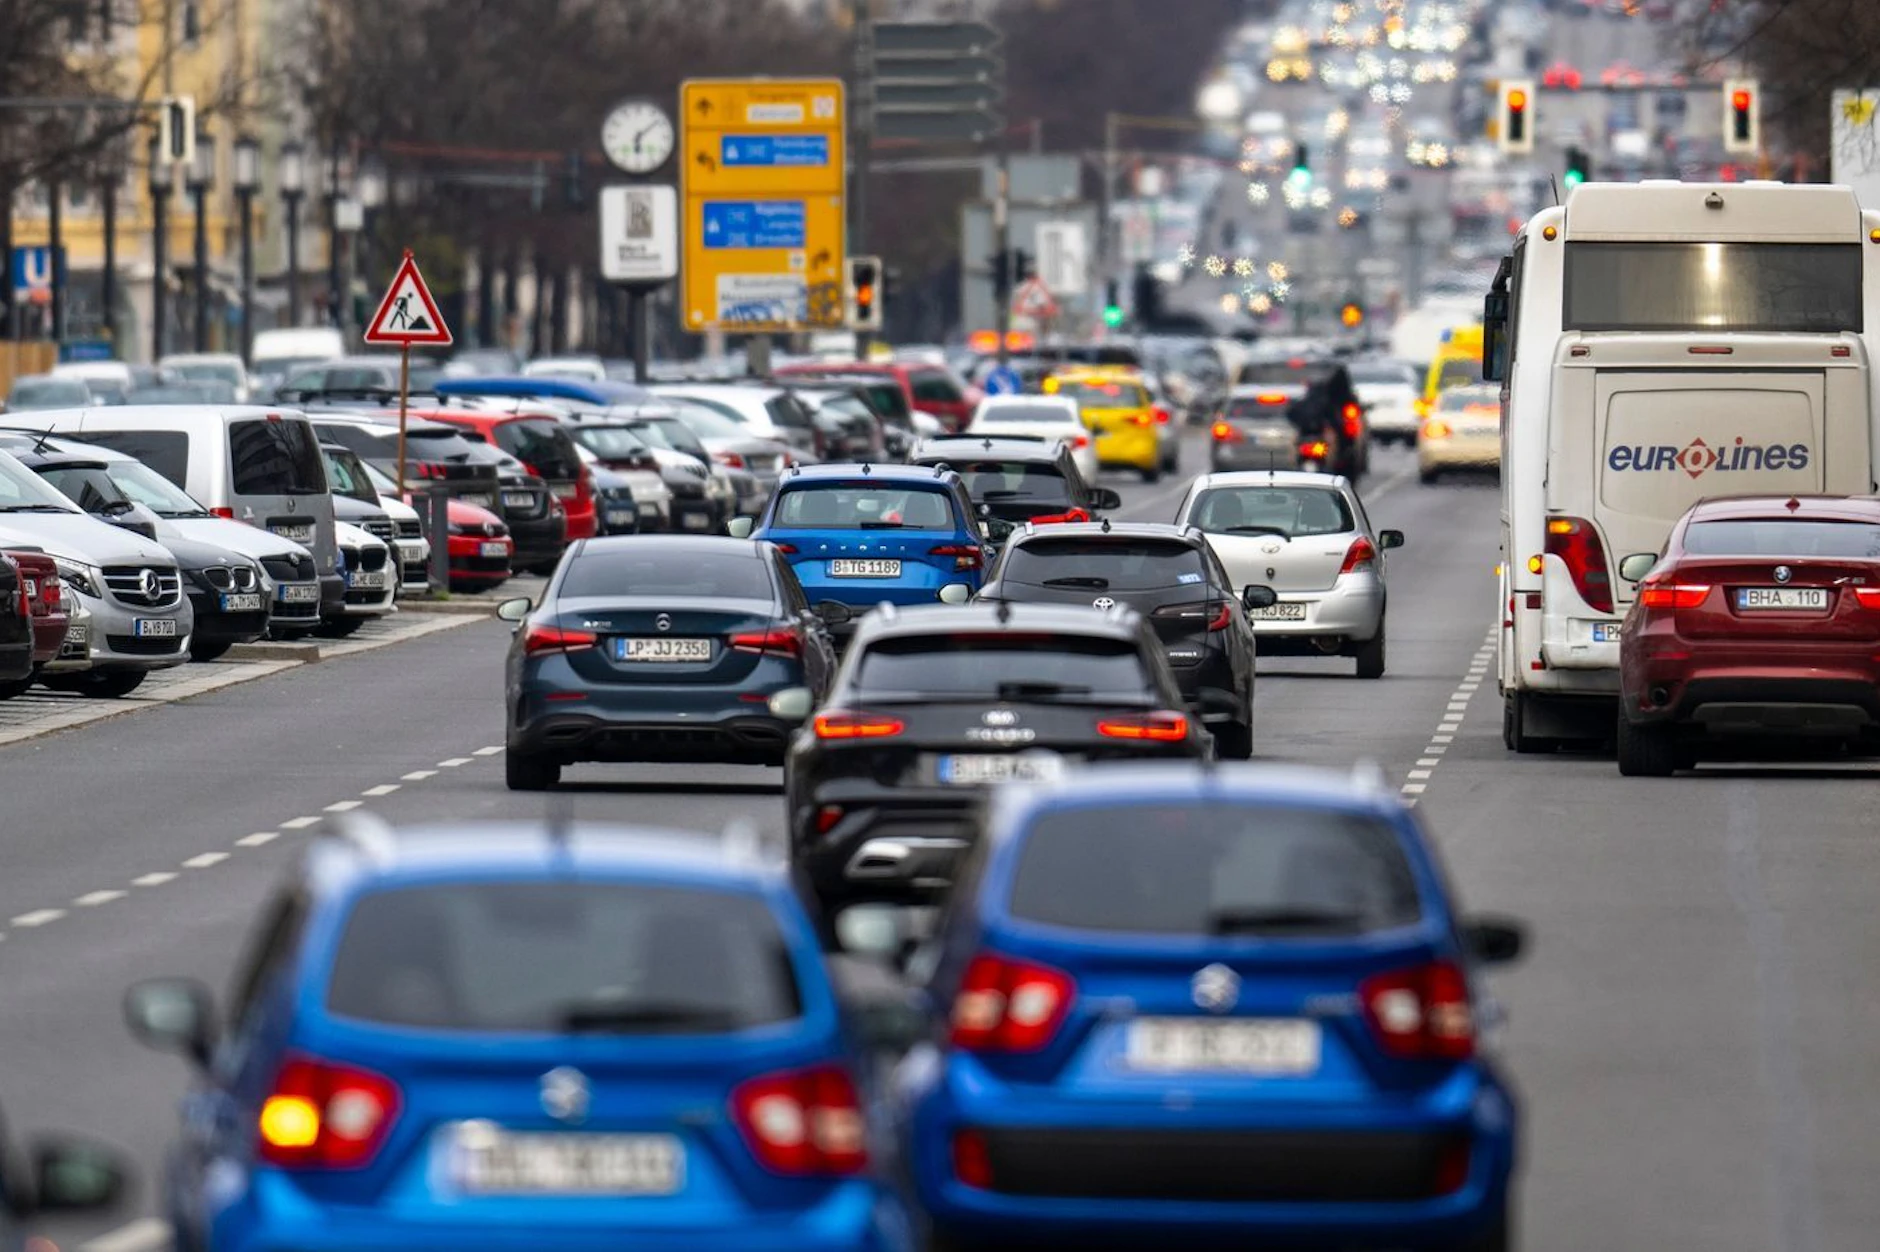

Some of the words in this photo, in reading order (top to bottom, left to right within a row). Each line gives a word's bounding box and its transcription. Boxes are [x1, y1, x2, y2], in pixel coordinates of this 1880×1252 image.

[833, 561, 842, 574] B
[850, 561, 866, 574] TG
[868, 561, 899, 574] 1189
[1749, 590, 1783, 605] BHA
[1797, 590, 1820, 605] 110
[1261, 605, 1277, 616] RJ
[1279, 605, 1300, 616] 822
[626, 641, 644, 656] LP
[654, 641, 672, 656] JJ
[674, 641, 709, 656] 2358
